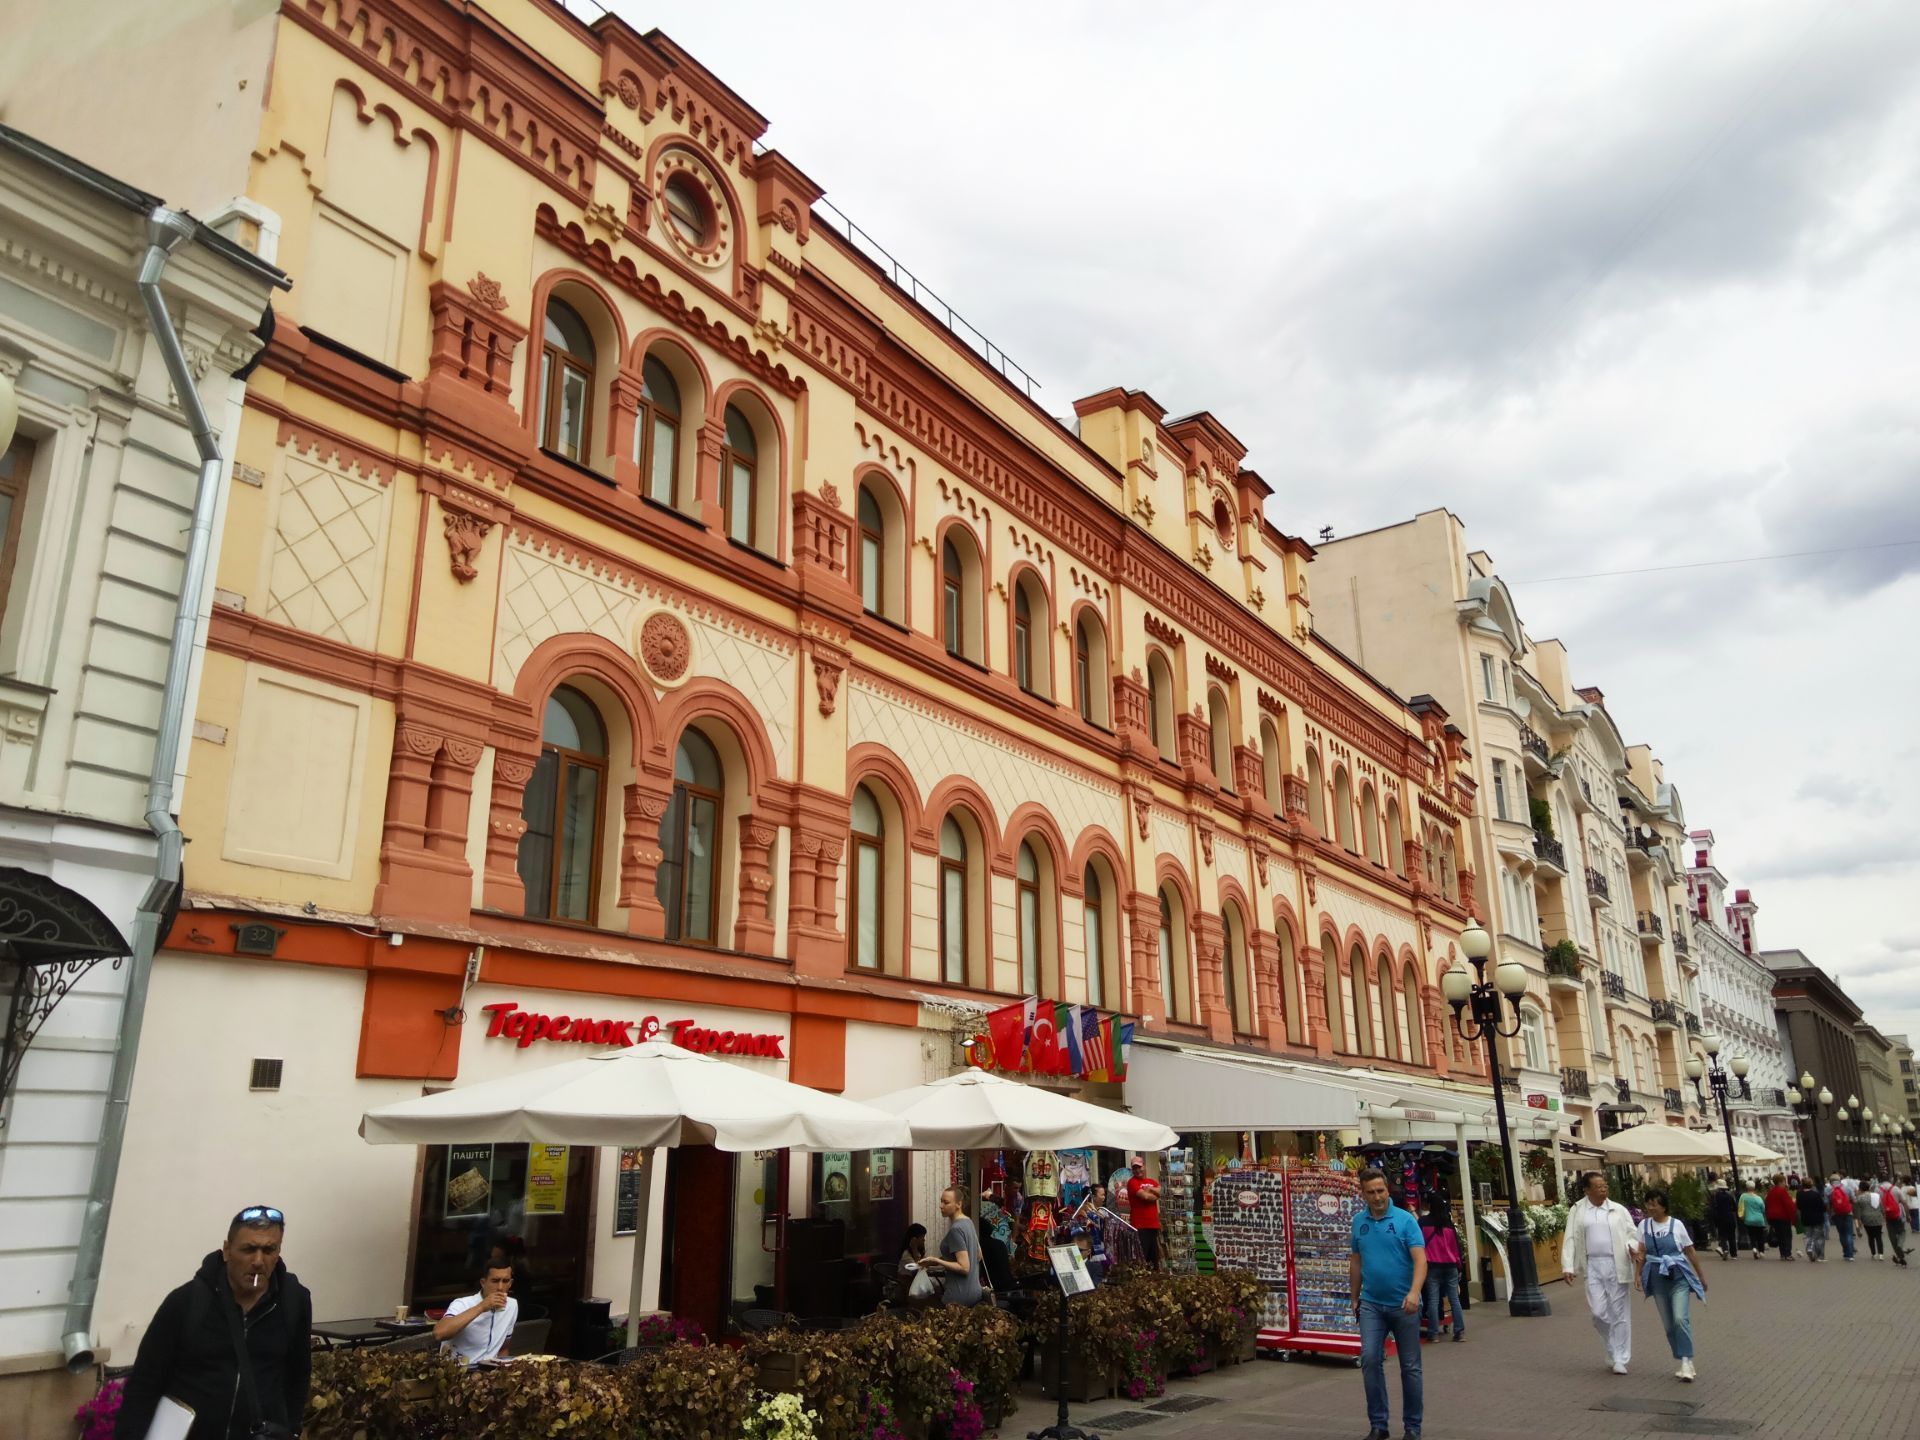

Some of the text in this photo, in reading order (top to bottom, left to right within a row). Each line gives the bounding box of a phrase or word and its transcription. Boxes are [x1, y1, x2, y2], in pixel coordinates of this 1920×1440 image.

[250, 928, 268, 942] 32
[482, 1002, 785, 1059] Теремок Теремок
[453, 1150, 490, 1160] ПАШТЕТ
